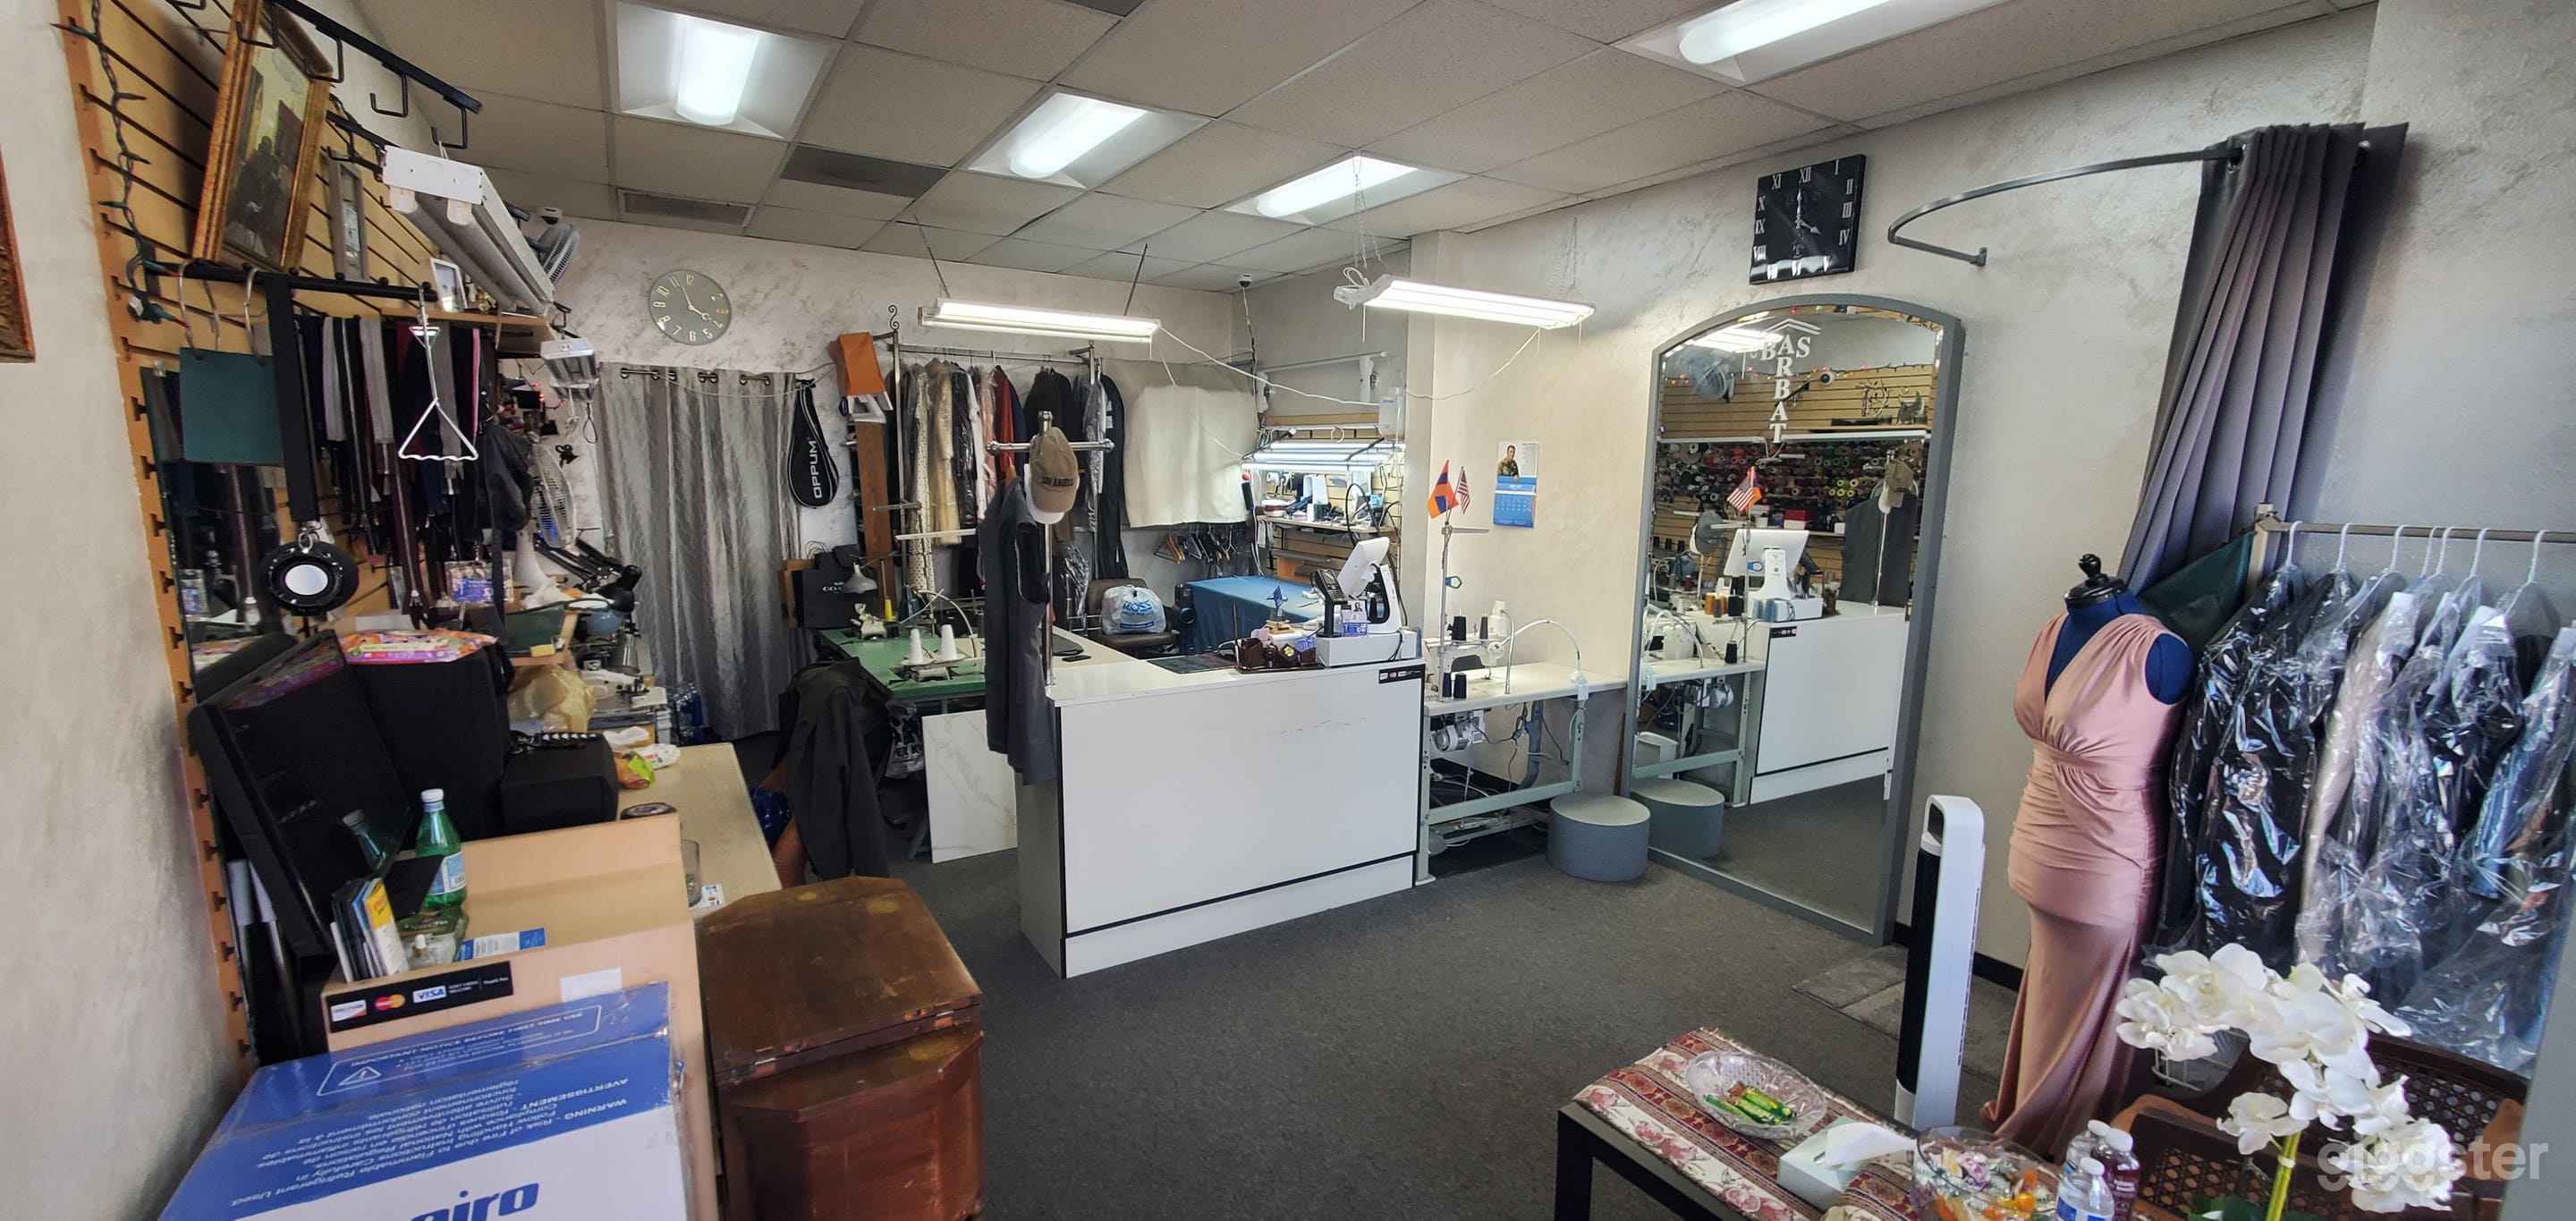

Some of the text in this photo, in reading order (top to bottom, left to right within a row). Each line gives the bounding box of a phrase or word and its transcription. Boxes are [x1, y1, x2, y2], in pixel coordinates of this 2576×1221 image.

[1772, 174, 1782, 190] XI
[1799, 166, 1811, 182] XII
[1846, 178, 1854, 195] II
[1758, 196, 1766, 211] X
[1842, 202, 1852, 218] III
[1755, 219, 1765, 234] IX
[1839, 229, 1851, 245] IV
[711, 293, 724, 301] 2
[673, 325, 713, 342] 7 6 5
[809, 440, 822, 499] OPPUM
[1123, 600, 1152, 612] ROSS
[419, 988, 444, 999] VISA
[351, 1049, 415, 1065] IMPORTANT
[420, 1040, 460, 1050] NOTICE
[521, 1079, 628, 1110] AVERTISSEMENT
[487, 1103, 557, 1126] Compliance
[565, 1099, 627, 1120] WARNING
[518, 1111, 556, 1125] Follow
[527, 1119, 552, 1131] Risk
[458, 1123, 483, 1134] with
[458, 1122, 513, 1140] Handling
[483, 1131, 506, 1141] Fire
[510, 1126, 522, 1135] of
[400, 1132, 453, 1149] National
[455, 1139, 479, 1149] due
[379, 1139, 453, 1161] Instructions
[438, 1146, 451, 1154] to
[313, 1157, 374, 1178] Carefully
[360, 1151, 434, 1174] Flammable
[275, 1170, 355, 1195] Refrigerant
